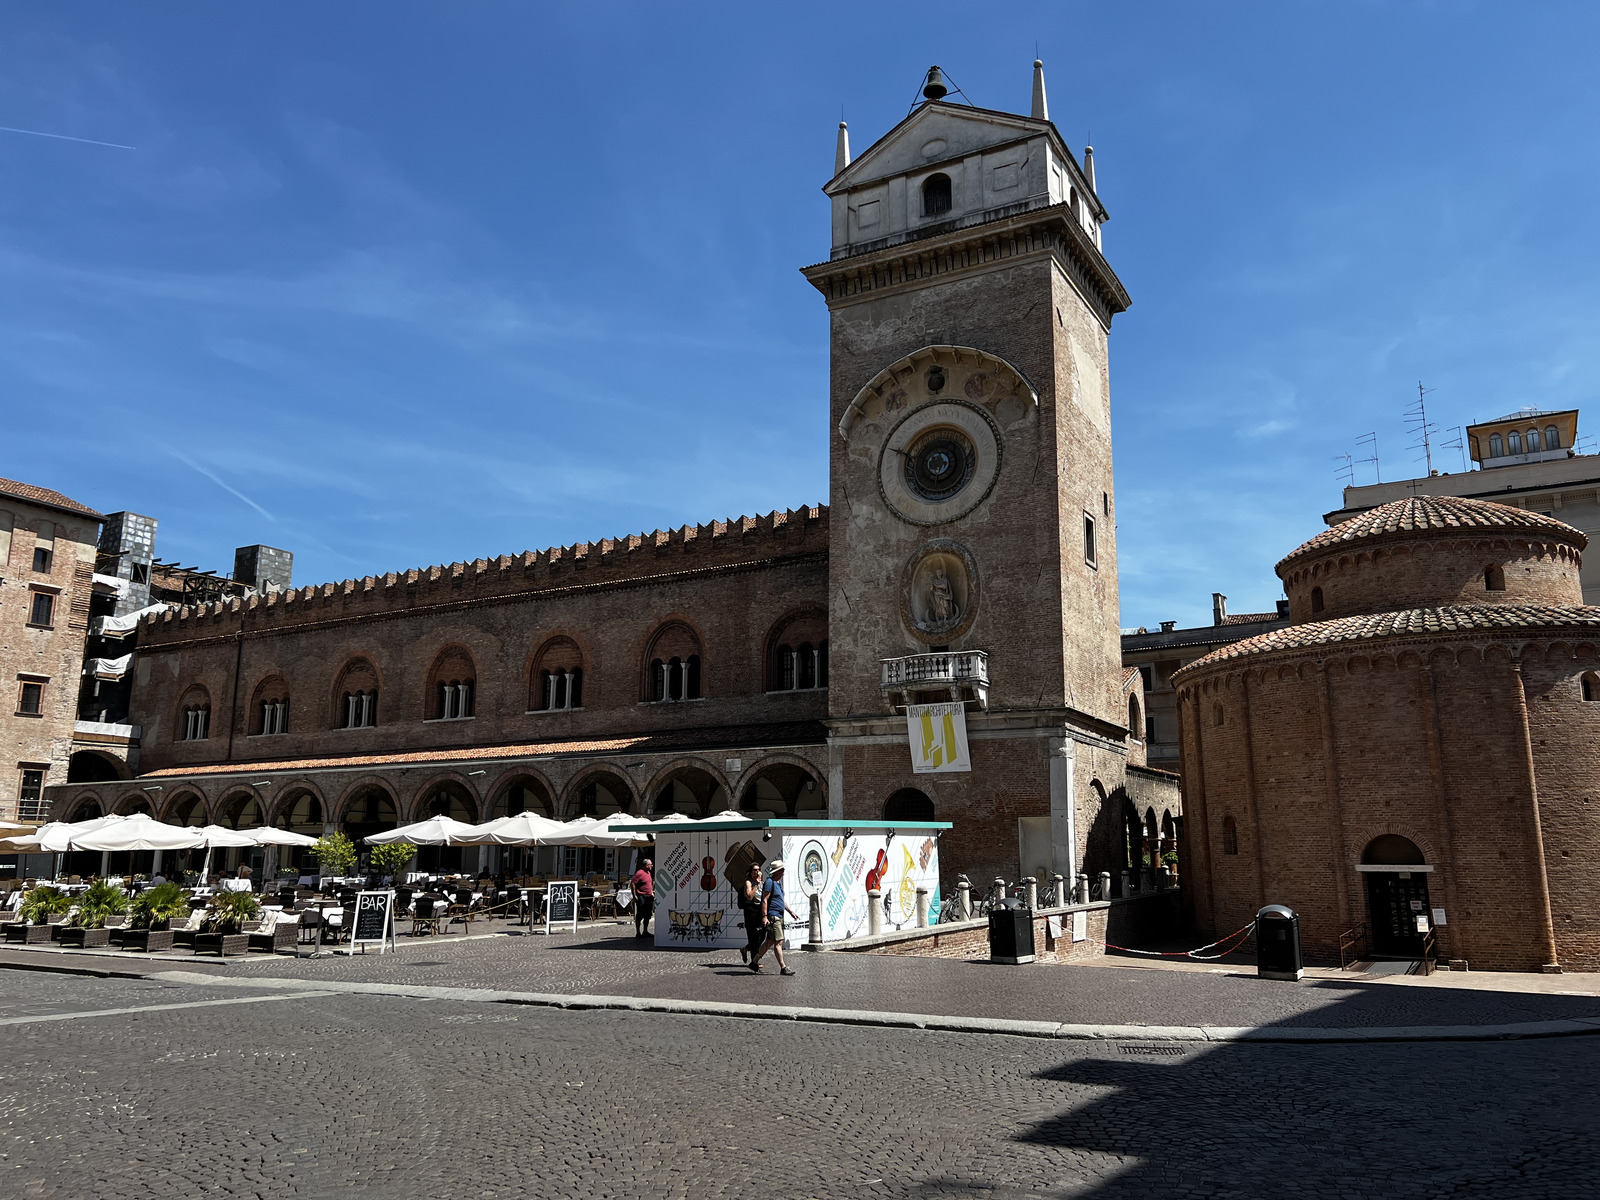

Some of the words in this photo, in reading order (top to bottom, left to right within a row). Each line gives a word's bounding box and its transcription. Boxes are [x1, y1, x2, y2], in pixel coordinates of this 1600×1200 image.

[663, 841, 685, 867] mantova
[667, 845, 688, 872] chamber
[671, 858, 686, 877] music
[655, 868, 675, 900] 10
[679, 862, 700, 889] INFOPOINT
[840, 863, 854, 894] 10
[360, 895, 386, 911] BAR
[826, 881, 843, 916] TRAME
[828, 890, 847, 931] SONORE
